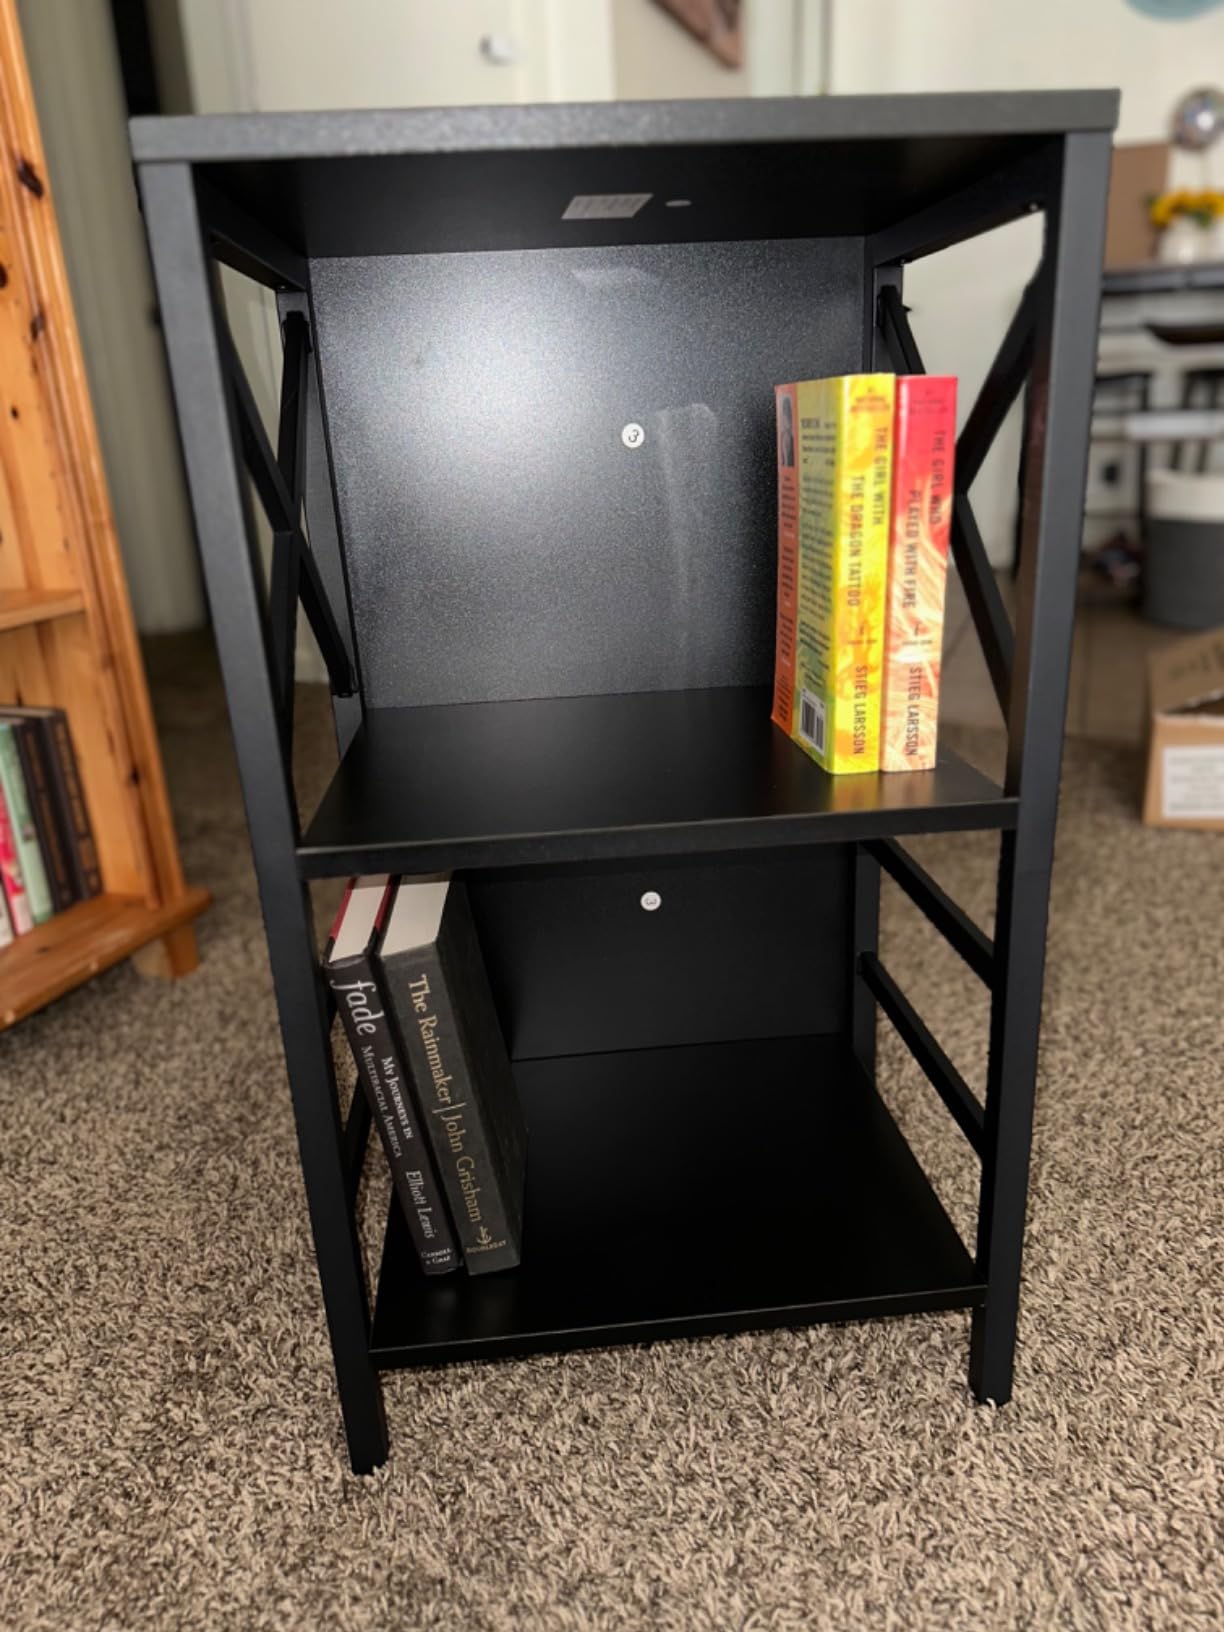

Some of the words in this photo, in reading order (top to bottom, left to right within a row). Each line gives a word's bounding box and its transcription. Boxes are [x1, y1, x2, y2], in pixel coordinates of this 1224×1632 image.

[873, 427, 889, 449] THE
[933, 431, 946, 451] THE
[851, 476, 865, 499] THE
[873, 457, 887, 485] GIRL
[930, 460, 945, 489] GIRL
[872, 491, 886, 526] WITH
[849, 504, 864, 557] DRAGON
[903, 543, 918, 575] WITH
[847, 562, 862, 607] TATTOO
[902, 580, 917, 609] FIRE
[854, 665, 868, 699] STIEG
[907, 666, 922, 701] STIEG
[853, 703, 867, 755] LARSSON
[905, 704, 920, 756] LARSSON
[329, 979, 385, 1036] fade
[408, 973, 431, 1013] The
[418, 1014, 453, 1104] Rainmaker
[440, 1114, 467, 1153] John
[405, 1170, 428, 1205] Elliott
[417, 1207, 438, 1239] Lewis
[456, 1155, 482, 1223] Grisham
